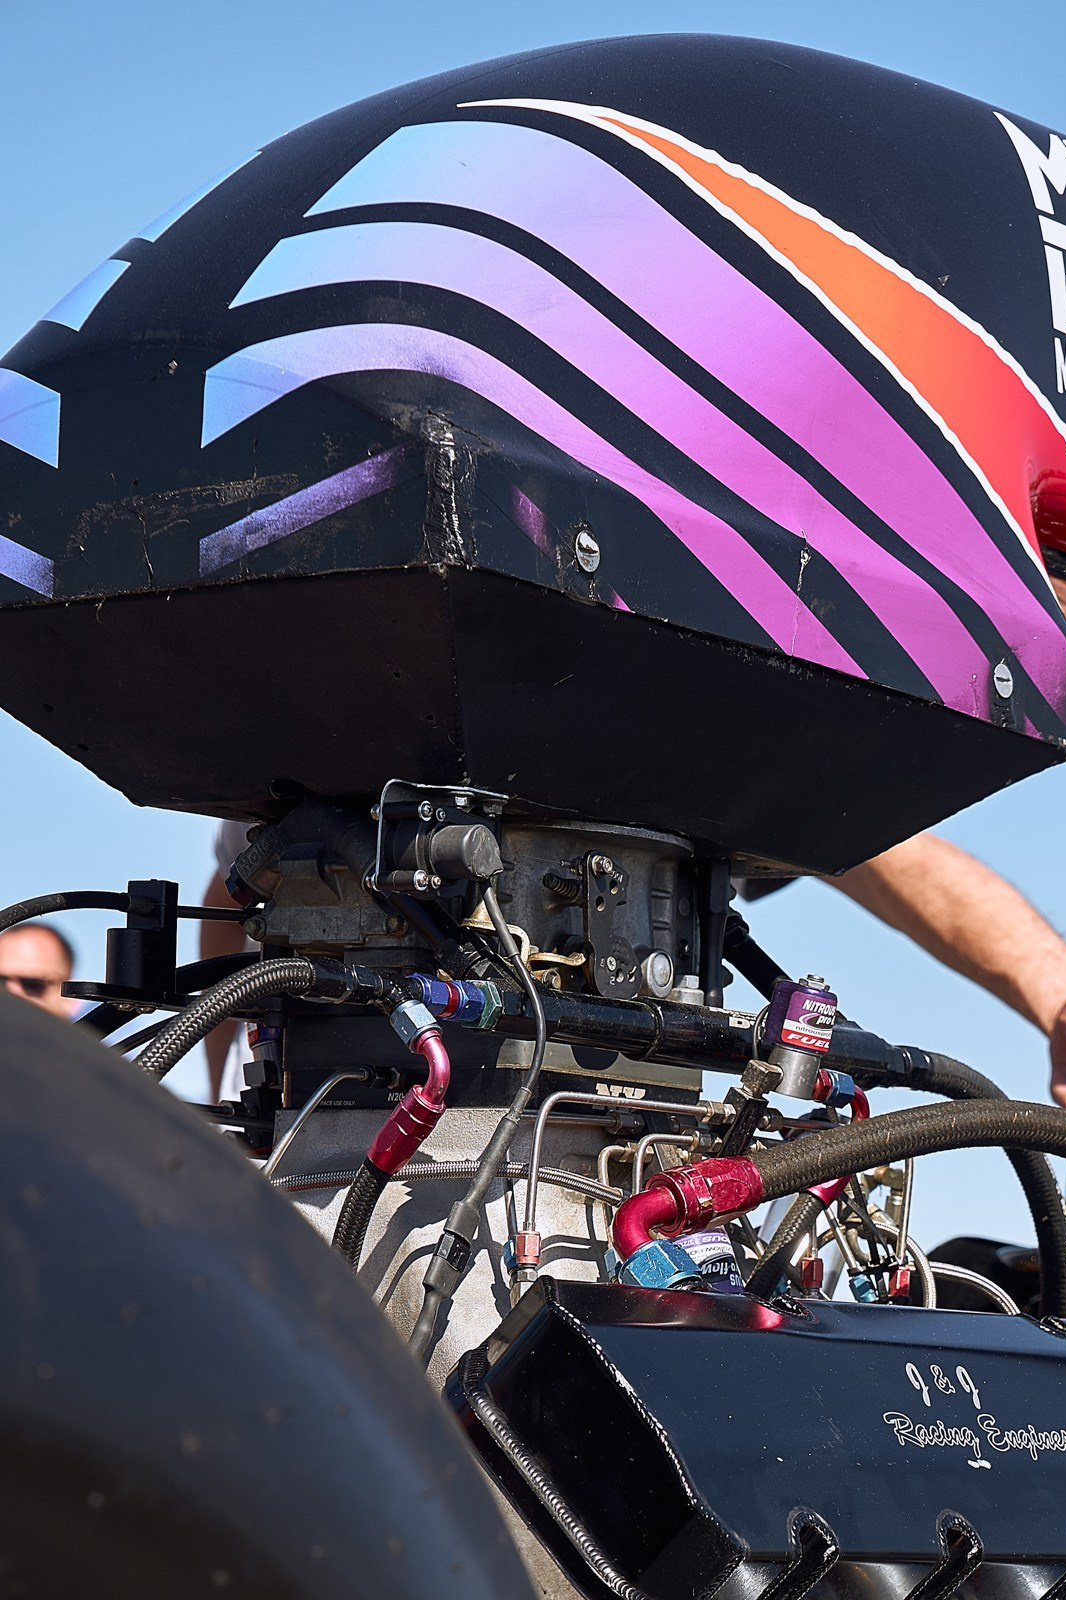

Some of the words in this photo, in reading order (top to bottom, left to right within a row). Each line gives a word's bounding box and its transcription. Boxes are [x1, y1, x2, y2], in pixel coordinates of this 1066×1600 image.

[786, 1033, 830, 1049] FUEL
[930, 1364, 956, 1394] &
[883, 1411, 981, 1459] Racing
